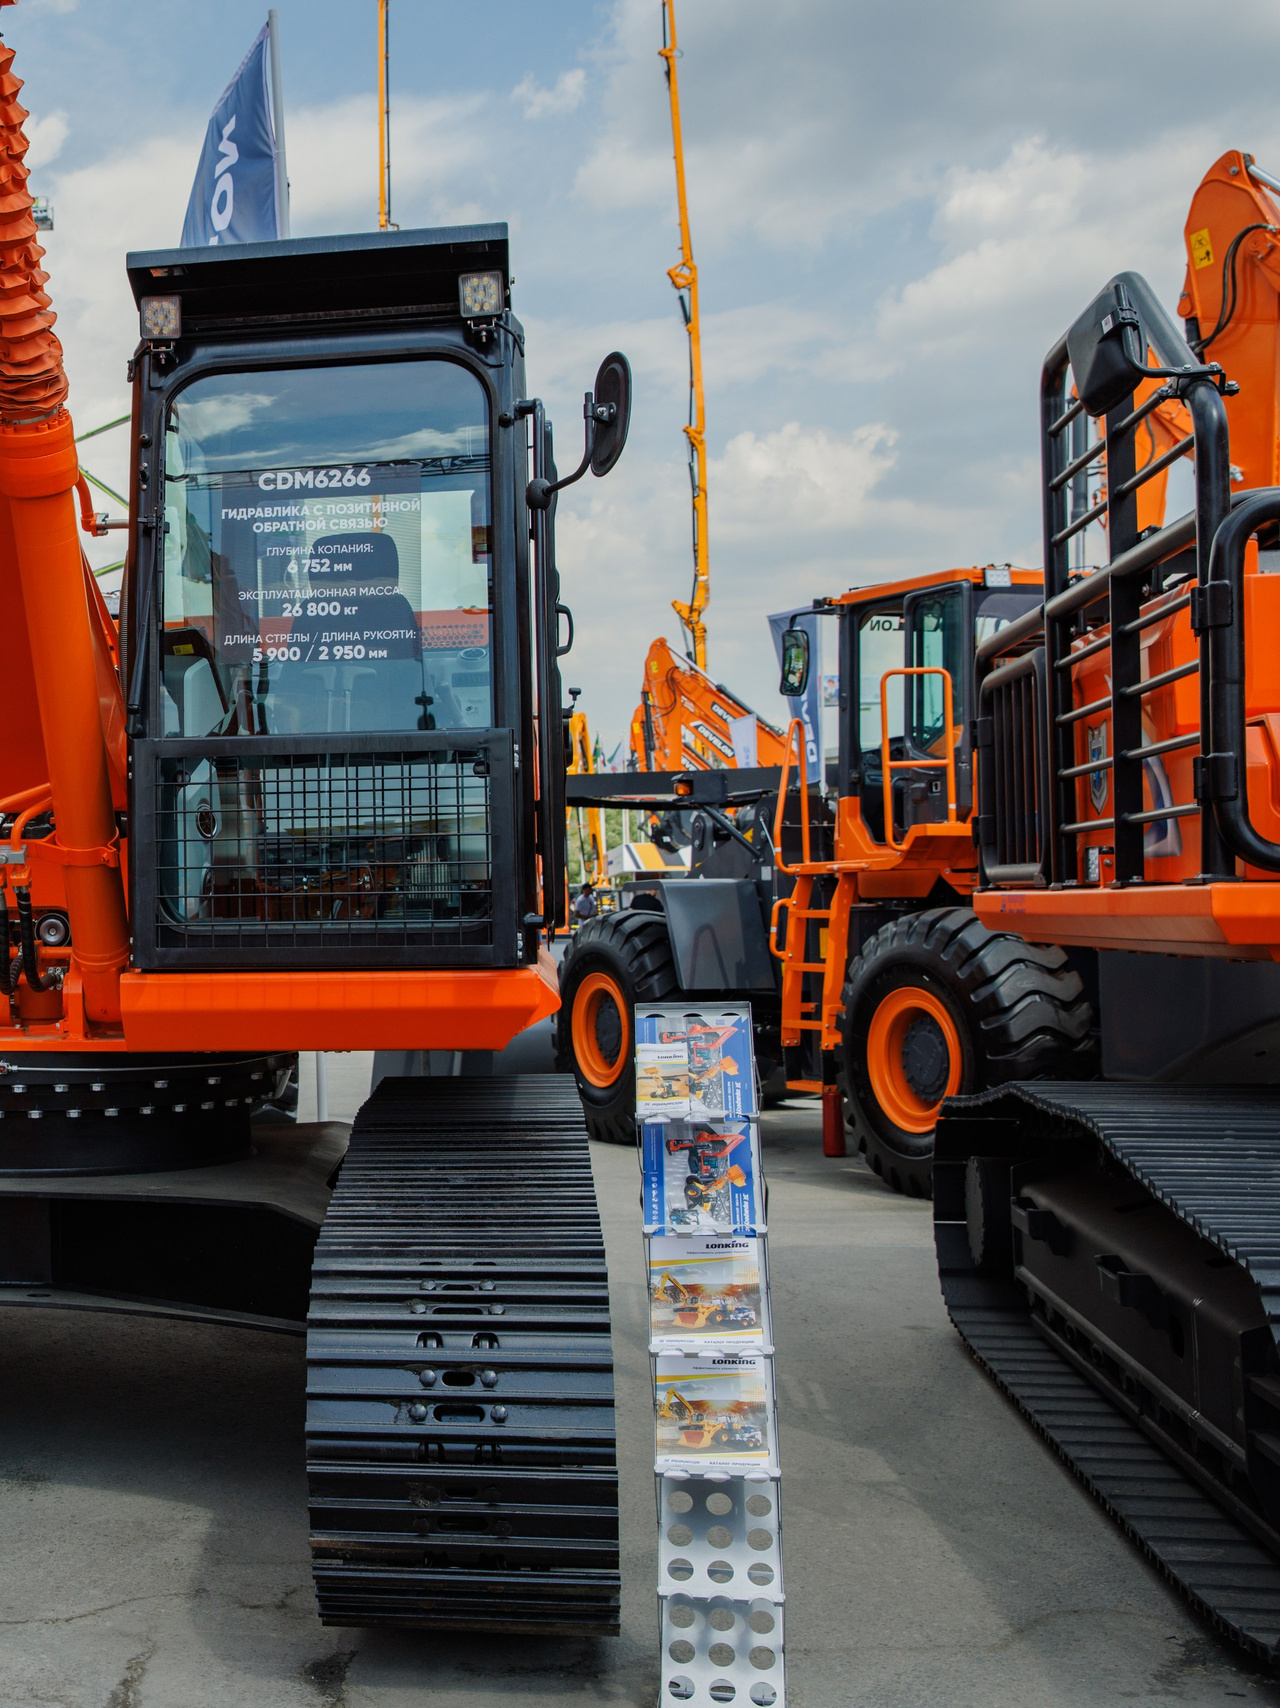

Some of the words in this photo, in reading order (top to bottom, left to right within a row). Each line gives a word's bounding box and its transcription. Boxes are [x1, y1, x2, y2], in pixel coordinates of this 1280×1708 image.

[258, 468, 371, 491] CDM6266
[221, 505, 310, 521] ГИДРАВЛИКА
[313, 504, 324, 515] С
[327, 498, 421, 515] ПОЗИТИВНОЙ
[252, 518, 326, 534] ОБРАТНОЙ
[329, 517, 389, 530] СВЯЗЬЮ
[266, 546, 315, 557] ГЛУБИНА
[318, 543, 374, 555] КОПАНИЯ:
[287, 560, 298, 574] 6
[301, 559, 331, 573] 752
[334, 562, 353, 572] мм
[237, 587, 357, 601] ЭКСПЛУАТАЦИОННАЯ
[359, 585, 403, 597] МАССА:
[282, 602, 303, 618] 26
[306, 601, 341, 617] 800
[343, 605, 358, 617] кг
[224, 634, 263, 646] ДЛИНА
[265, 633, 310, 644] СТРЕЛЫ
[312, 632, 319, 643] /
[321, 631, 361, 643] ДЛИНА
[363, 629, 417, 641] РУКОЯТИ:
[252, 648, 263, 662] 5
[267, 647, 301, 662] 900
[305, 645, 315, 662] /
[318, 646, 329, 661] 2
[333, 645, 366, 660] 950
[368, 649, 388, 659] мм
[697, 725, 734, 758] DEVELON
